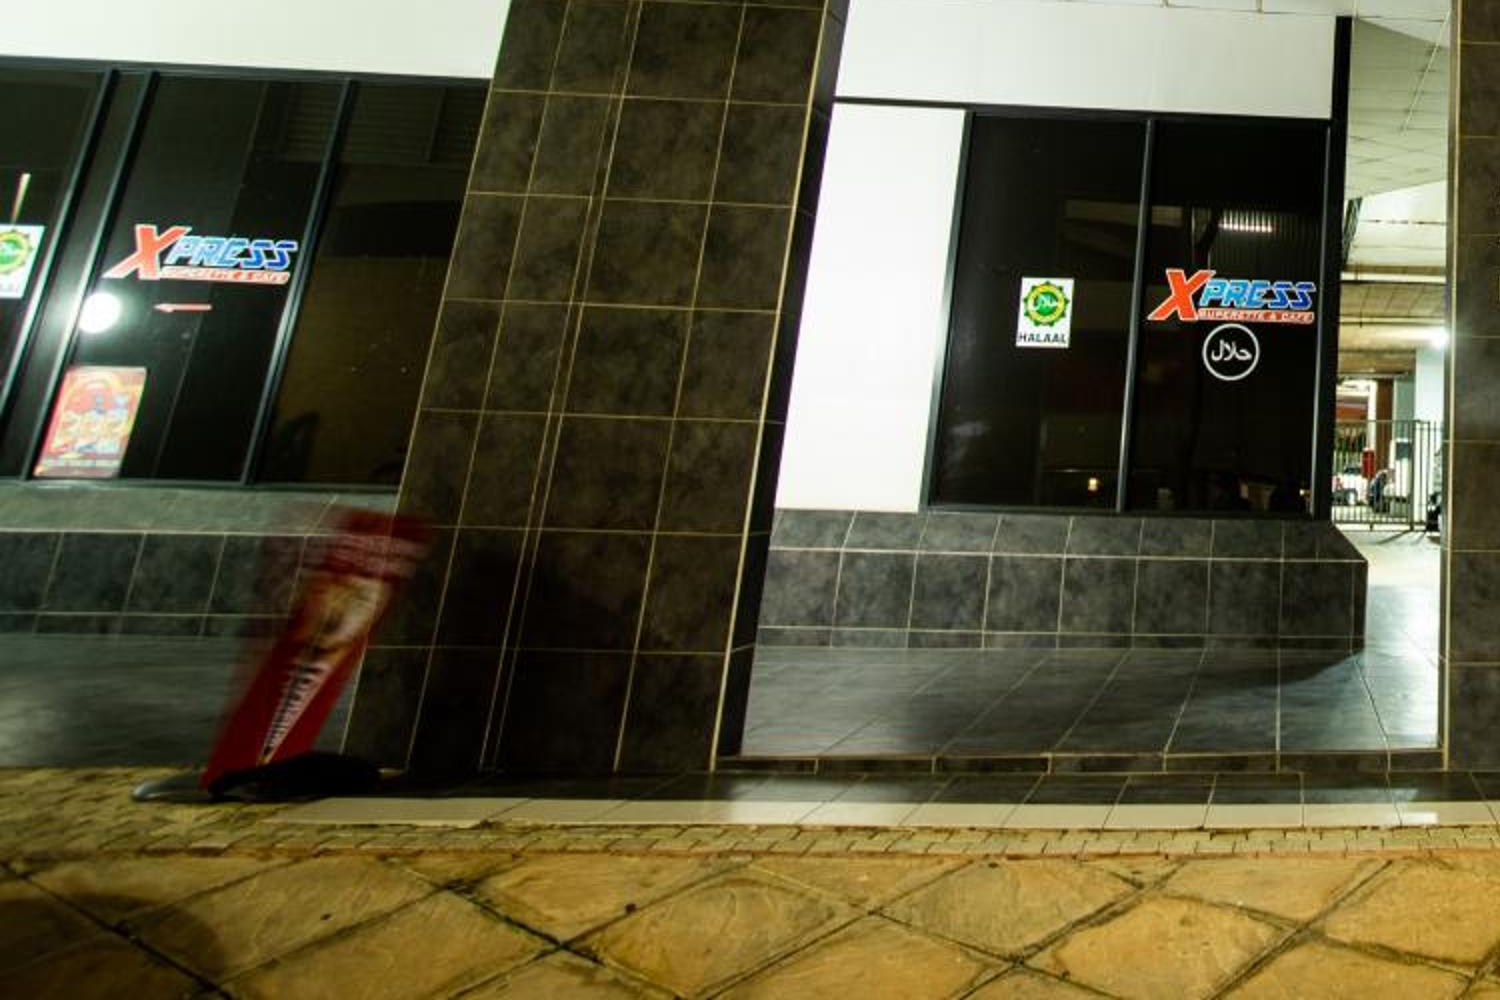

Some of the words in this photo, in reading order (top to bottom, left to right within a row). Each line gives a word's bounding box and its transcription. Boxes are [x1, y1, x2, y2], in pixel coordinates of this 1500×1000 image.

[102, 224, 298, 281] XPRESS
[1147, 268, 1317, 322] XPRESS
[1018, 333, 1066, 343] HALAAL
